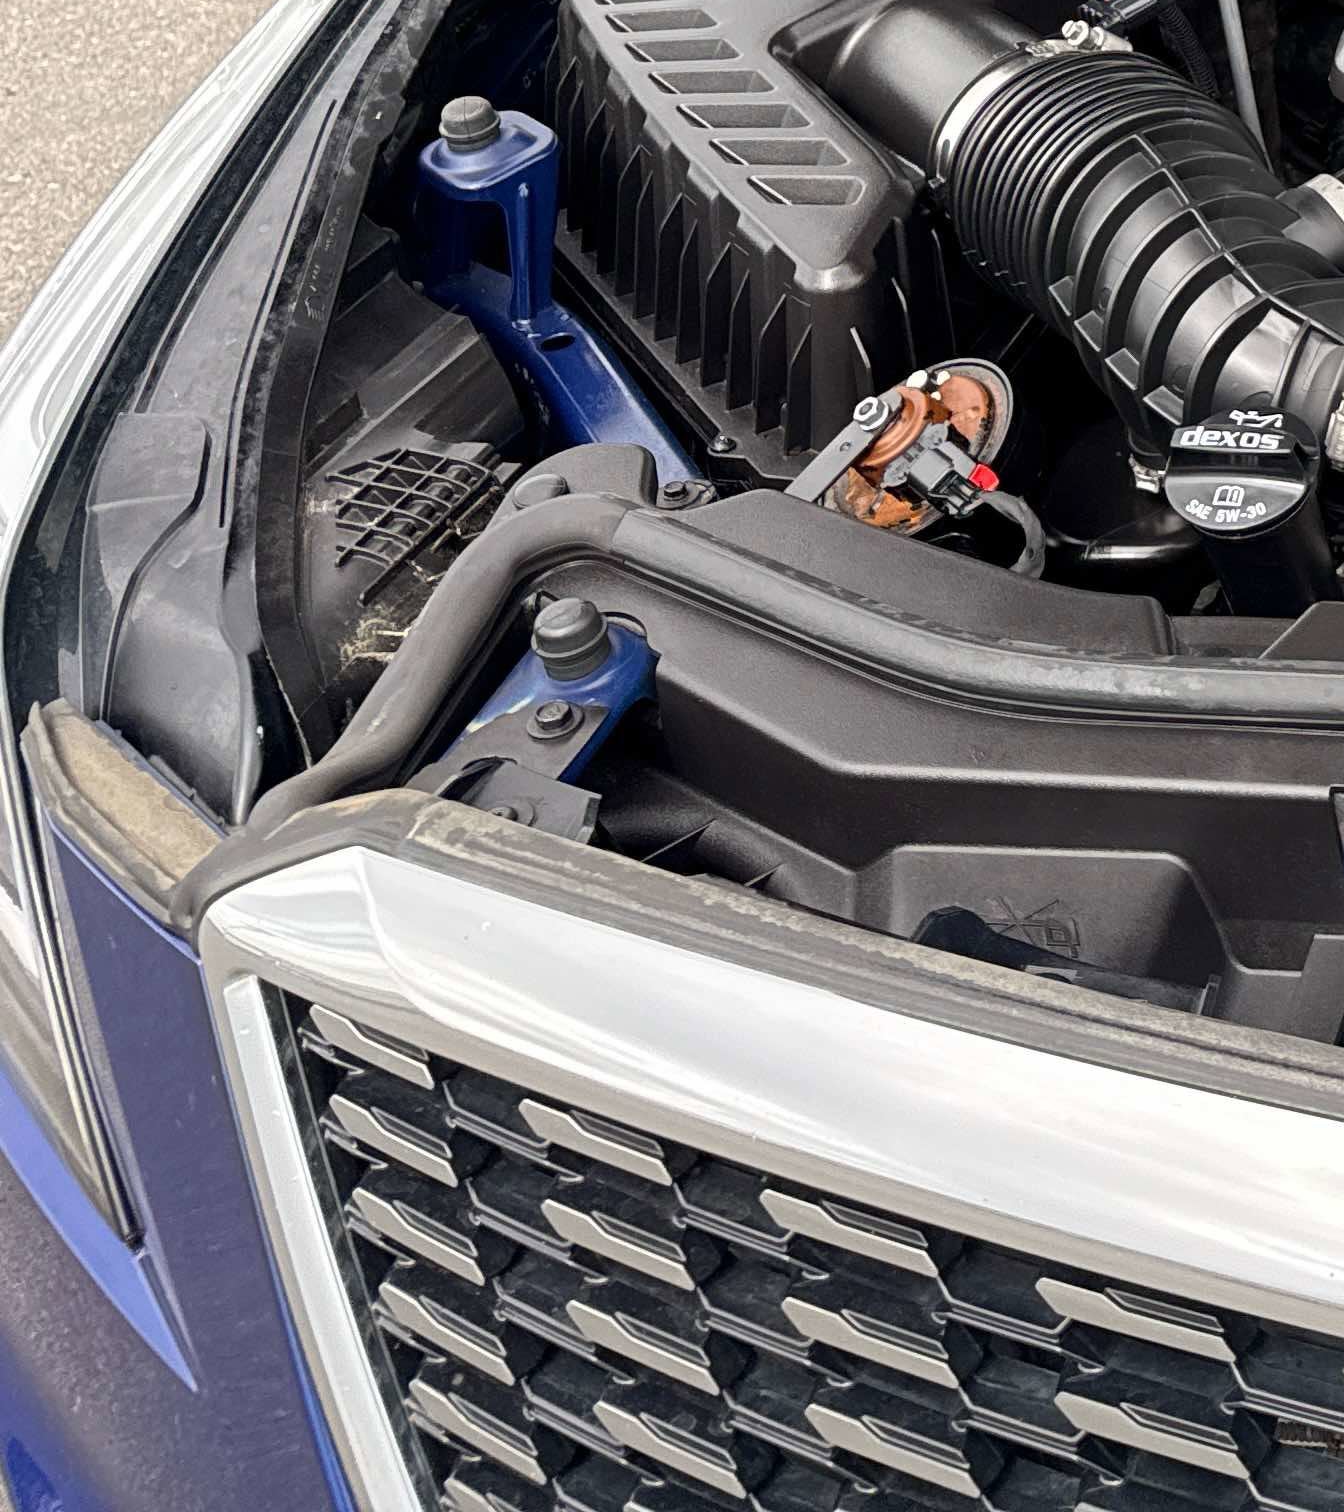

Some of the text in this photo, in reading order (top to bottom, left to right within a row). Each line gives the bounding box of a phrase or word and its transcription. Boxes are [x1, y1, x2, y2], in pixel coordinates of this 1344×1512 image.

[1180, 426, 1284, 449] dexos
[1186, 499, 1266, 522] SAE 5W-30
